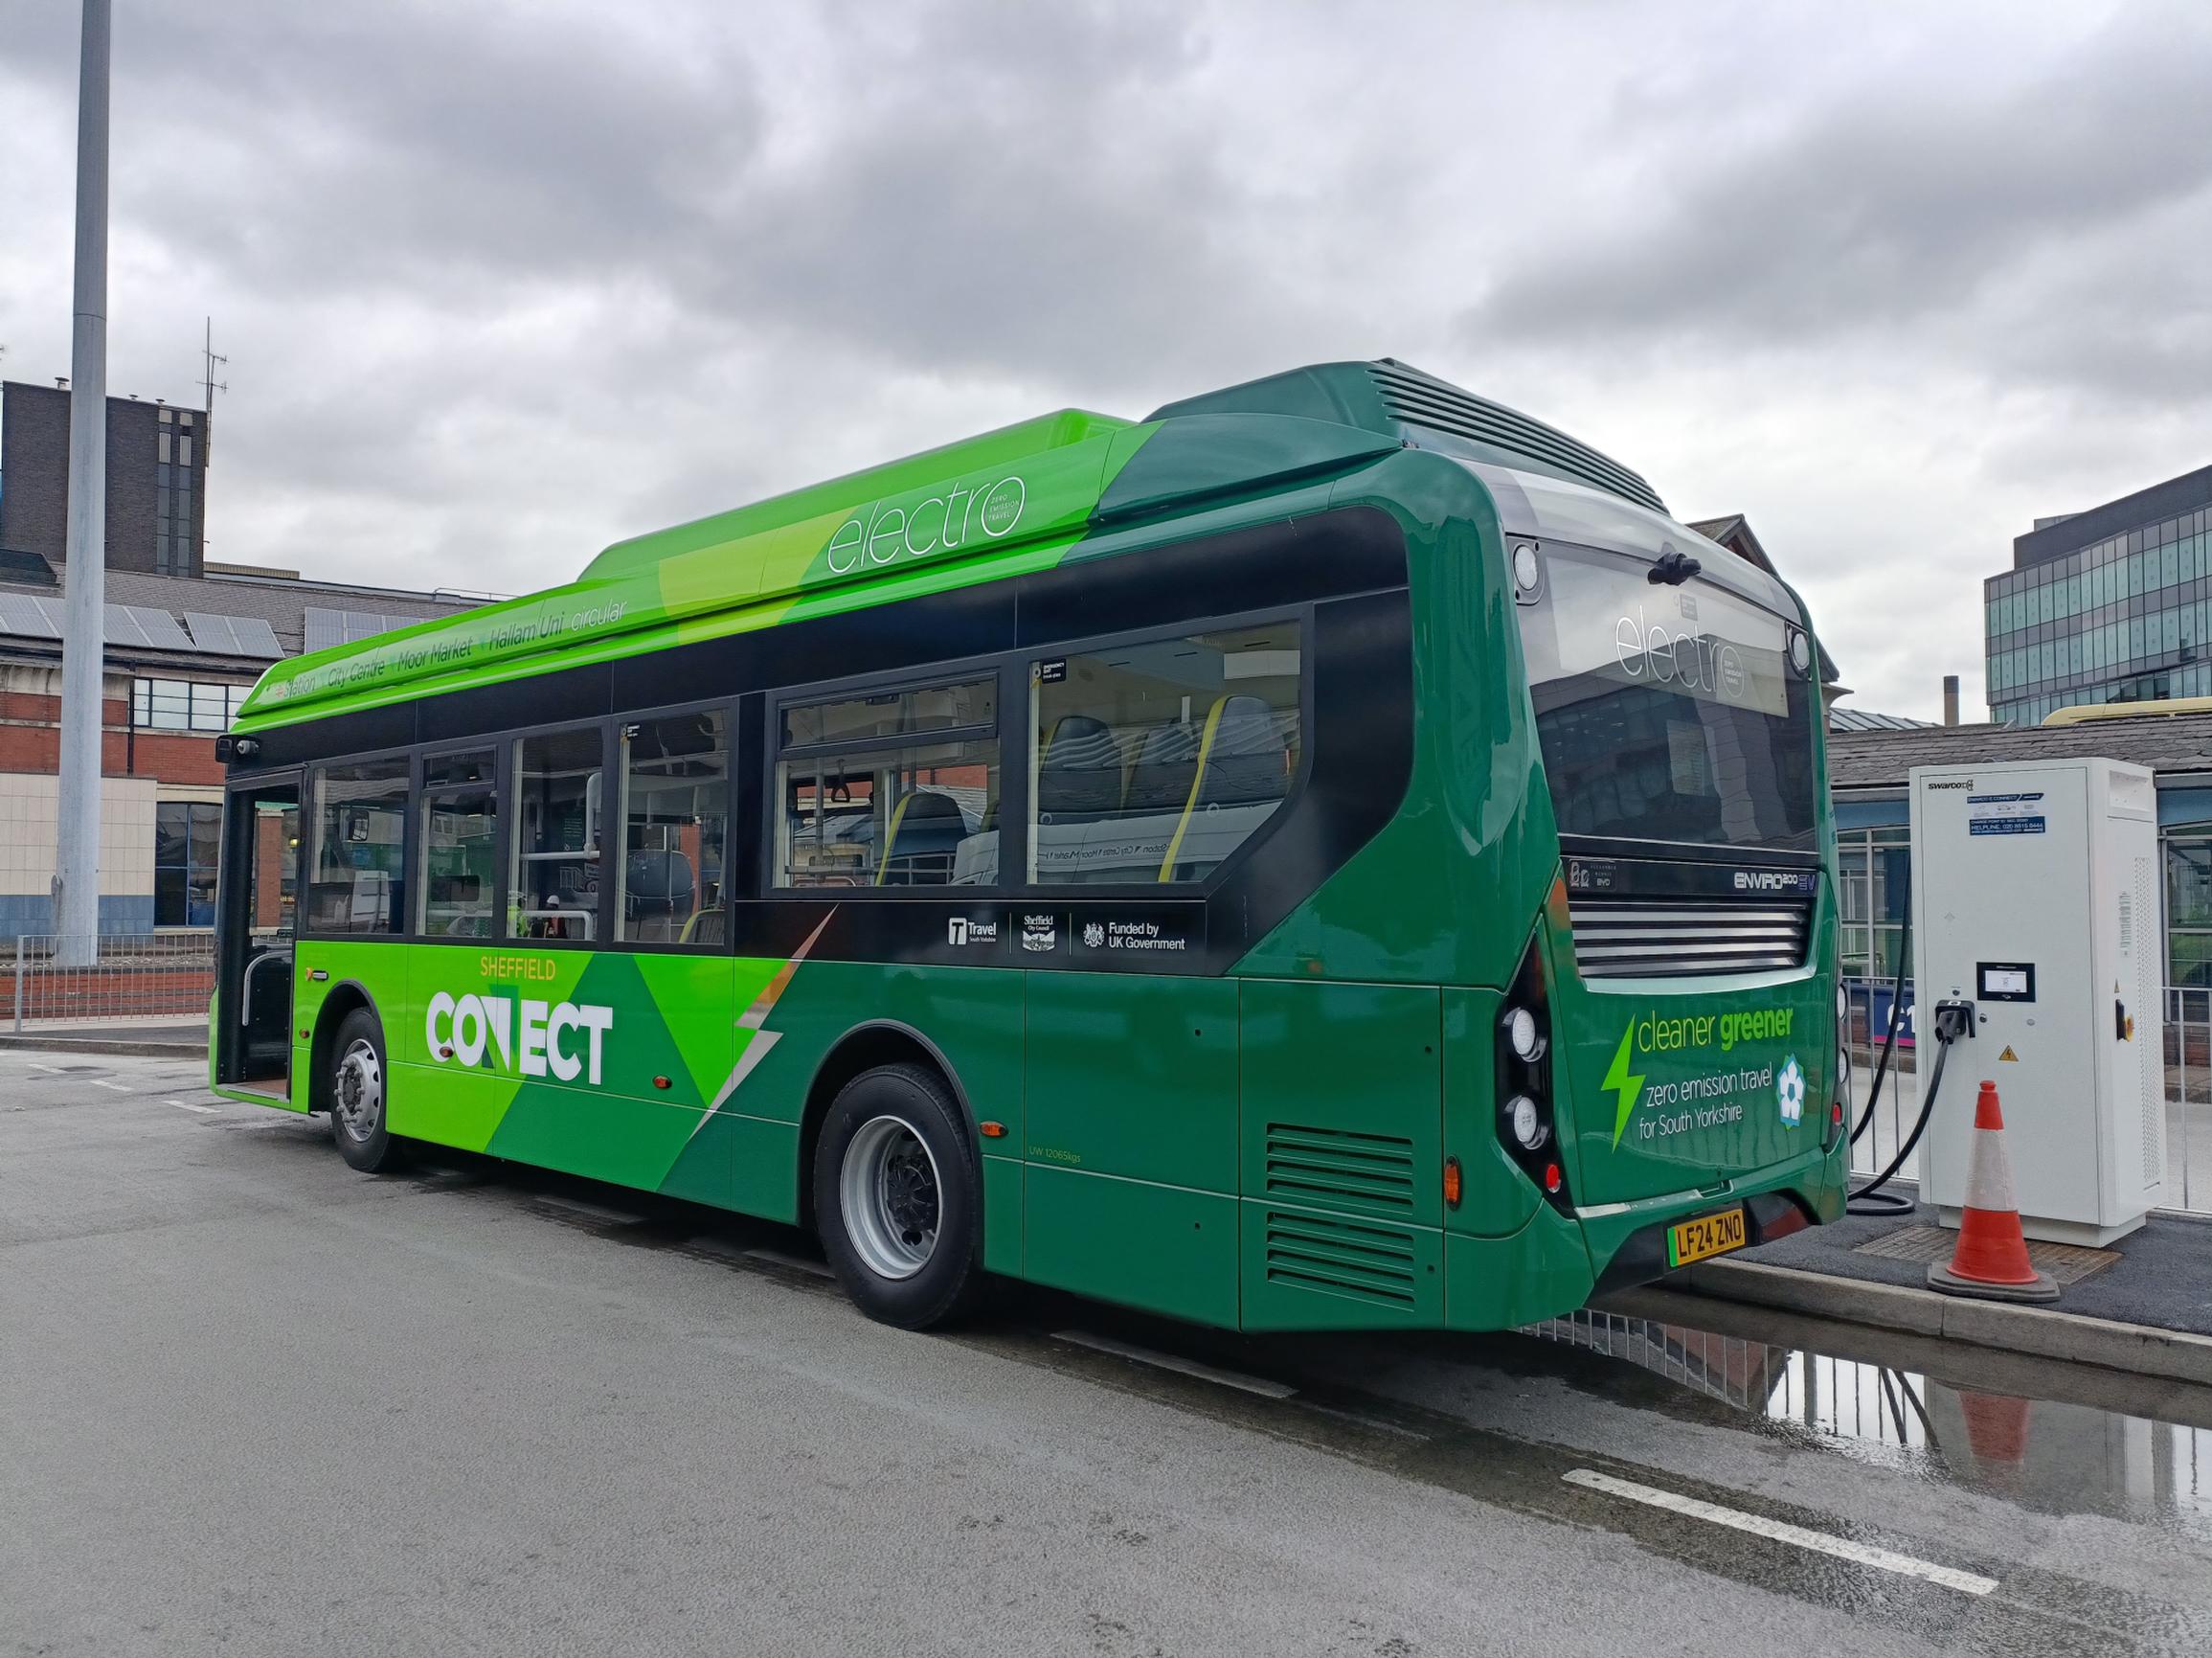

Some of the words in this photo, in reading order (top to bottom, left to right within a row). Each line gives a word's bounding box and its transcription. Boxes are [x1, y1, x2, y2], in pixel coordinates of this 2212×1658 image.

[827, 475, 1026, 574] electro
[283, 675, 316, 697] Station
[327, 665, 348, 689] City
[350, 659, 385, 681] Centre
[397, 649, 429, 672] Moor
[430, 635, 473, 665] Market
[488, 623, 537, 650] Hallam
[538, 611, 565, 638] Uni
[571, 598, 628, 631] circular
[1615, 604, 1745, 698] electro
[1928, 782, 1962, 790] swarco
[967, 921, 997, 936] Travel
[1024, 915, 1053, 925] Sheffield
[1108, 921, 1144, 935] Funded
[1146, 922, 1160, 938] by
[1108, 936, 1123, 948] UK
[1125, 937, 1185, 950] Government
[480, 955, 556, 981] SHEFFIELD
[1638, 1010, 1716, 1053] cleaner
[1720, 1008, 1794, 1051] greener
[1646, 1083, 1678, 1107] zero
[1681, 1069, 1738, 1102] emission
[1740, 1061, 1772, 1091] travel
[1638, 1117, 1657, 1141] for
[1659, 1109, 1693, 1137] South
[1694, 1102, 1743, 1129] Yorkshire
[1028, 1146, 1044, 1156] UW
[1677, 1222, 1714, 1258] LF24
[1715, 1214, 1742, 1246] ZNO
